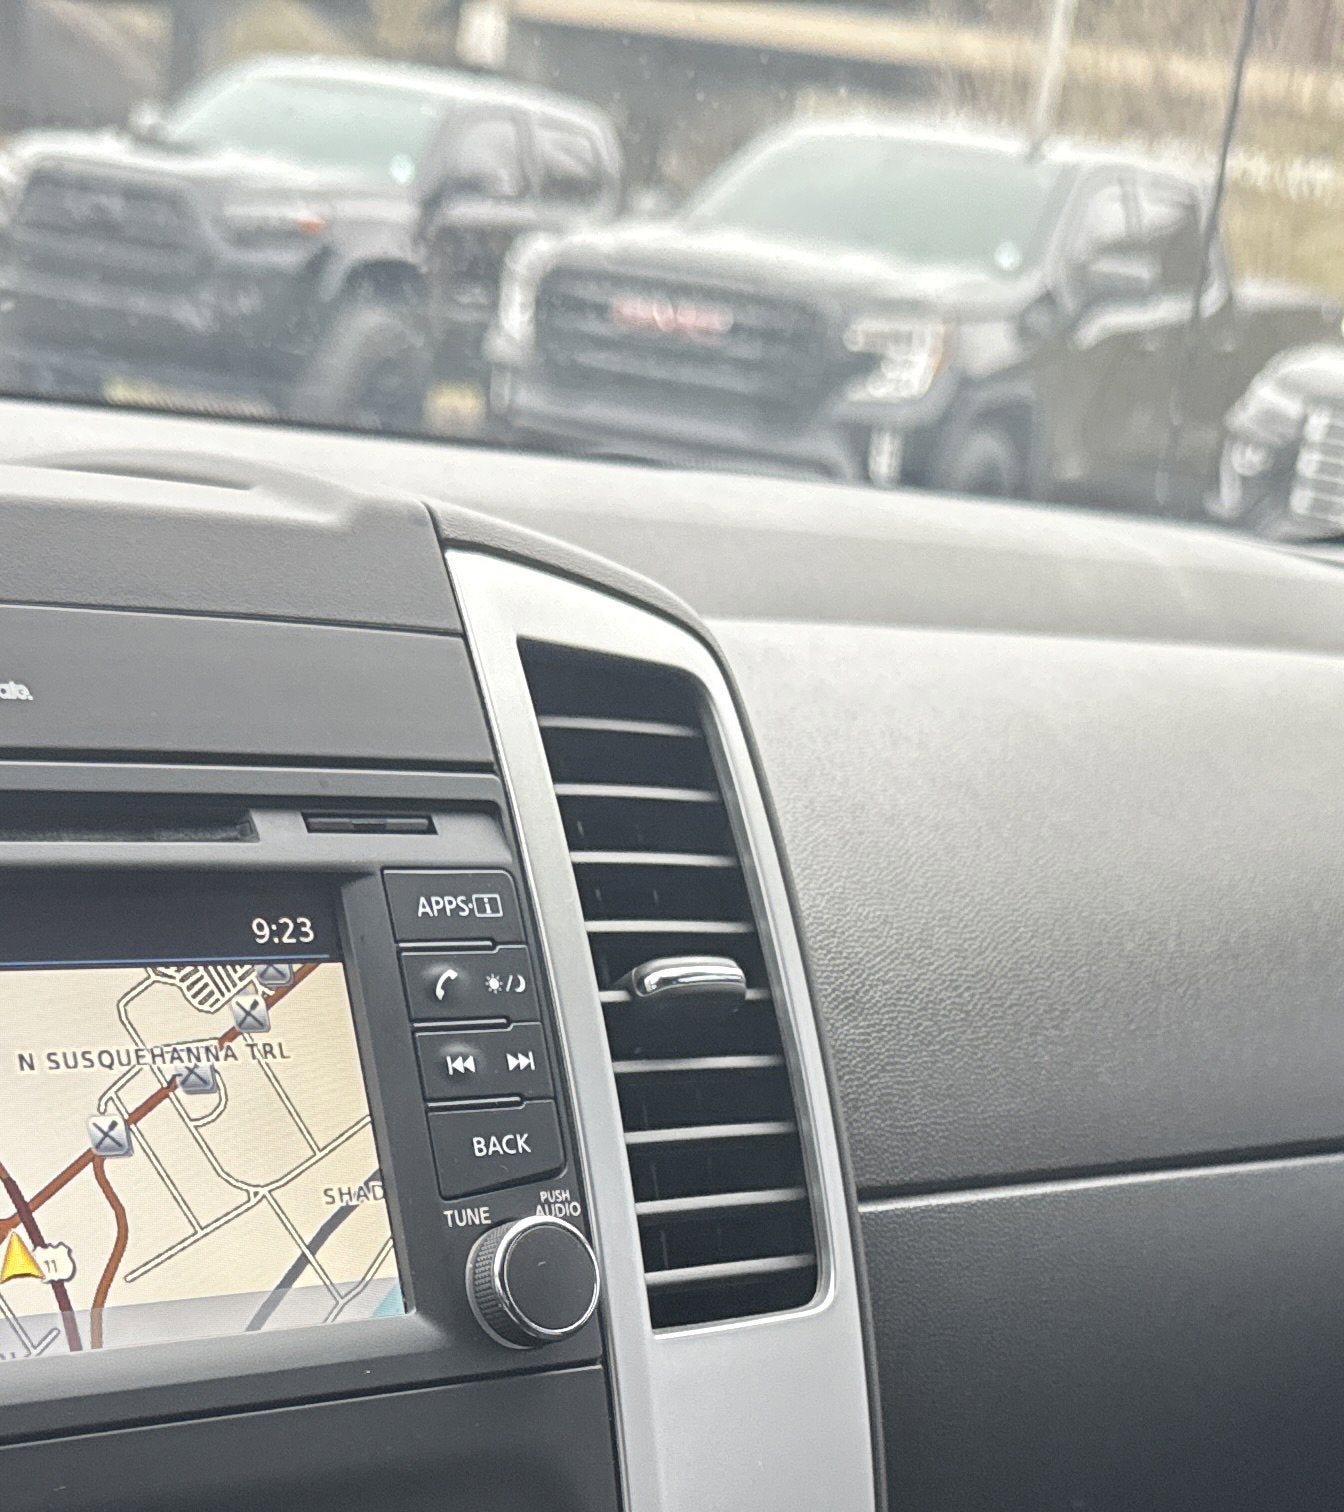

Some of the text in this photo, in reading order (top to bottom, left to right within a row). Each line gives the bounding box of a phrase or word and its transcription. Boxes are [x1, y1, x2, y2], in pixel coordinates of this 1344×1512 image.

[251, 917, 316, 944] 9:23
[17, 1041, 292, 1072] N SUSQUEHANNA TRL
[472, 1133, 532, 1158] BACK
[540, 1188, 571, 1204] PUSH
[443, 1206, 492, 1228] TUNE
[535, 1201, 582, 1219] AUDIO
[43, 1258, 58, 1274] 11
